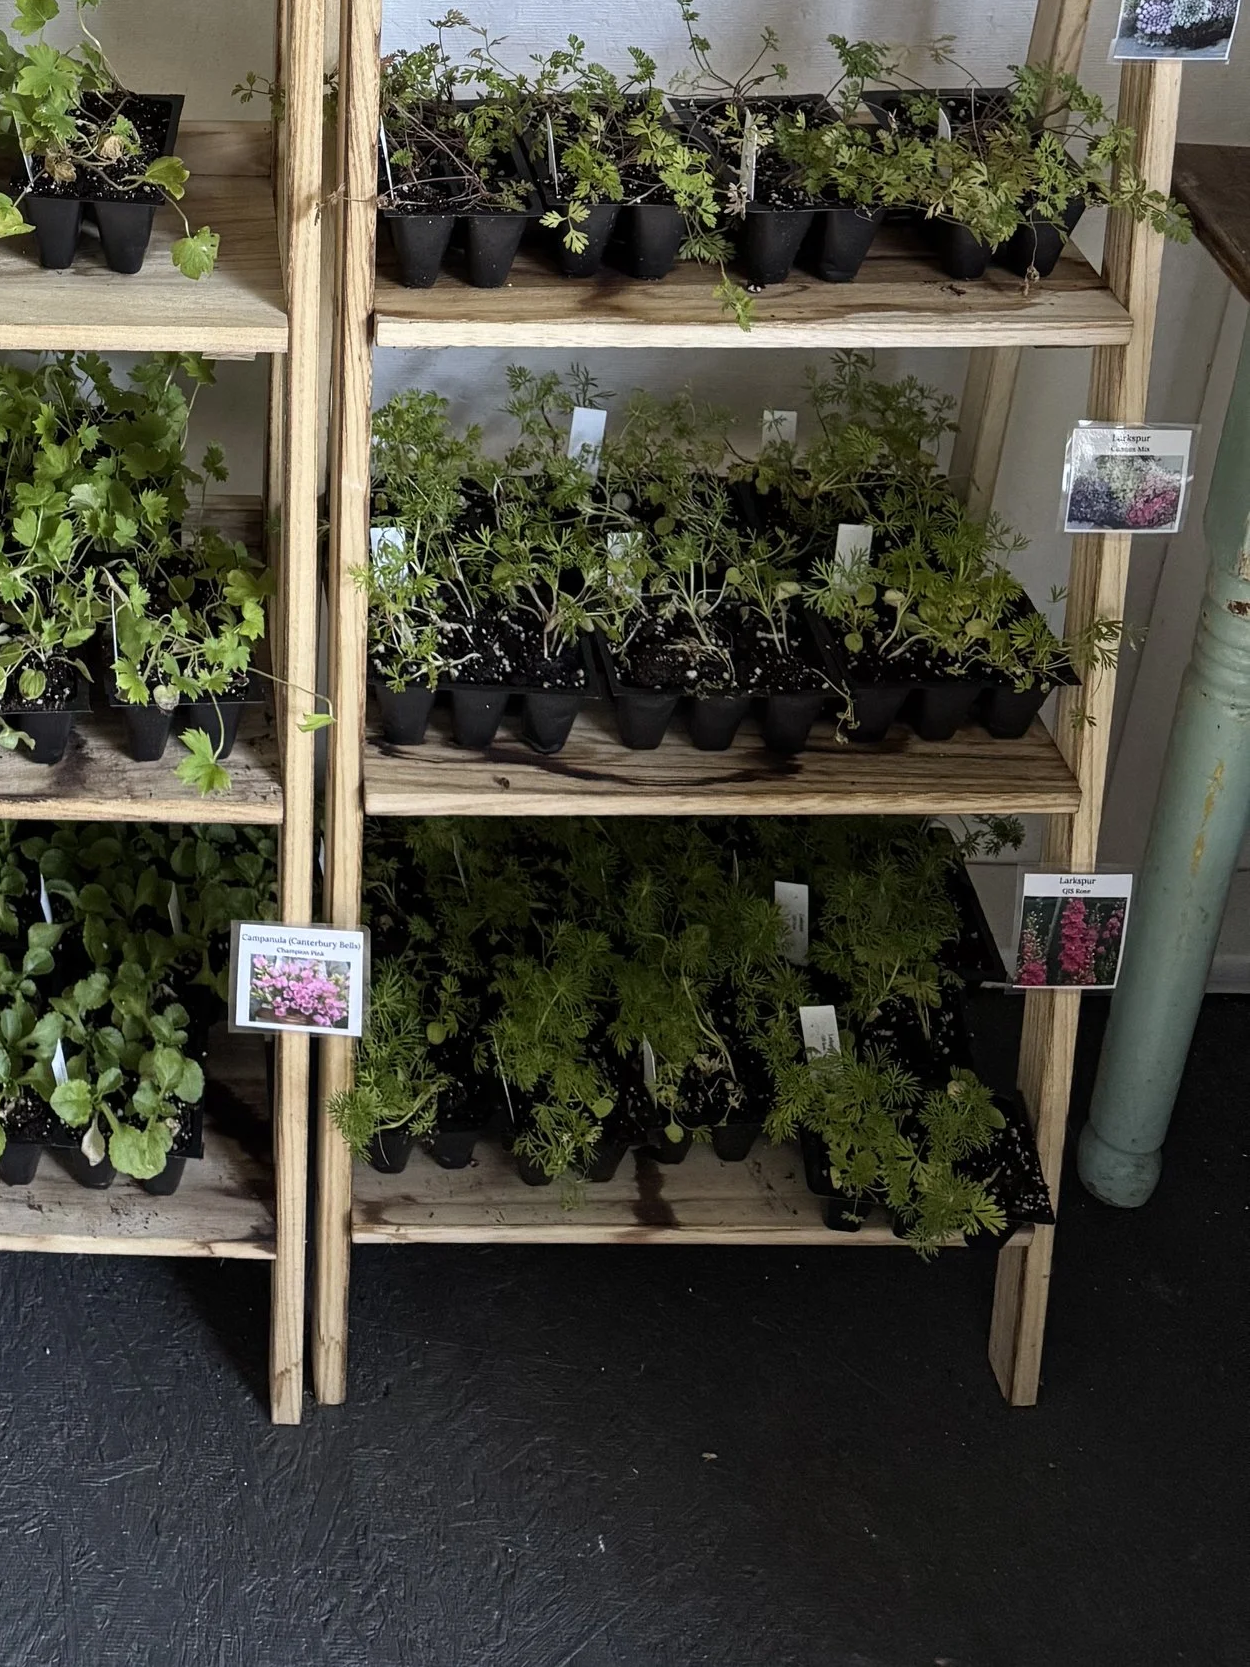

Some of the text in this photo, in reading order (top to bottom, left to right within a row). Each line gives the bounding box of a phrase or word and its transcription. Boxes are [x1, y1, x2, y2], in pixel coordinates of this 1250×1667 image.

[1112, 434, 1151, 444] Larkspur
[1059, 877, 1097, 886] Larkspur
[241, 934, 361, 950] Campanula (Canterbury Bells)
